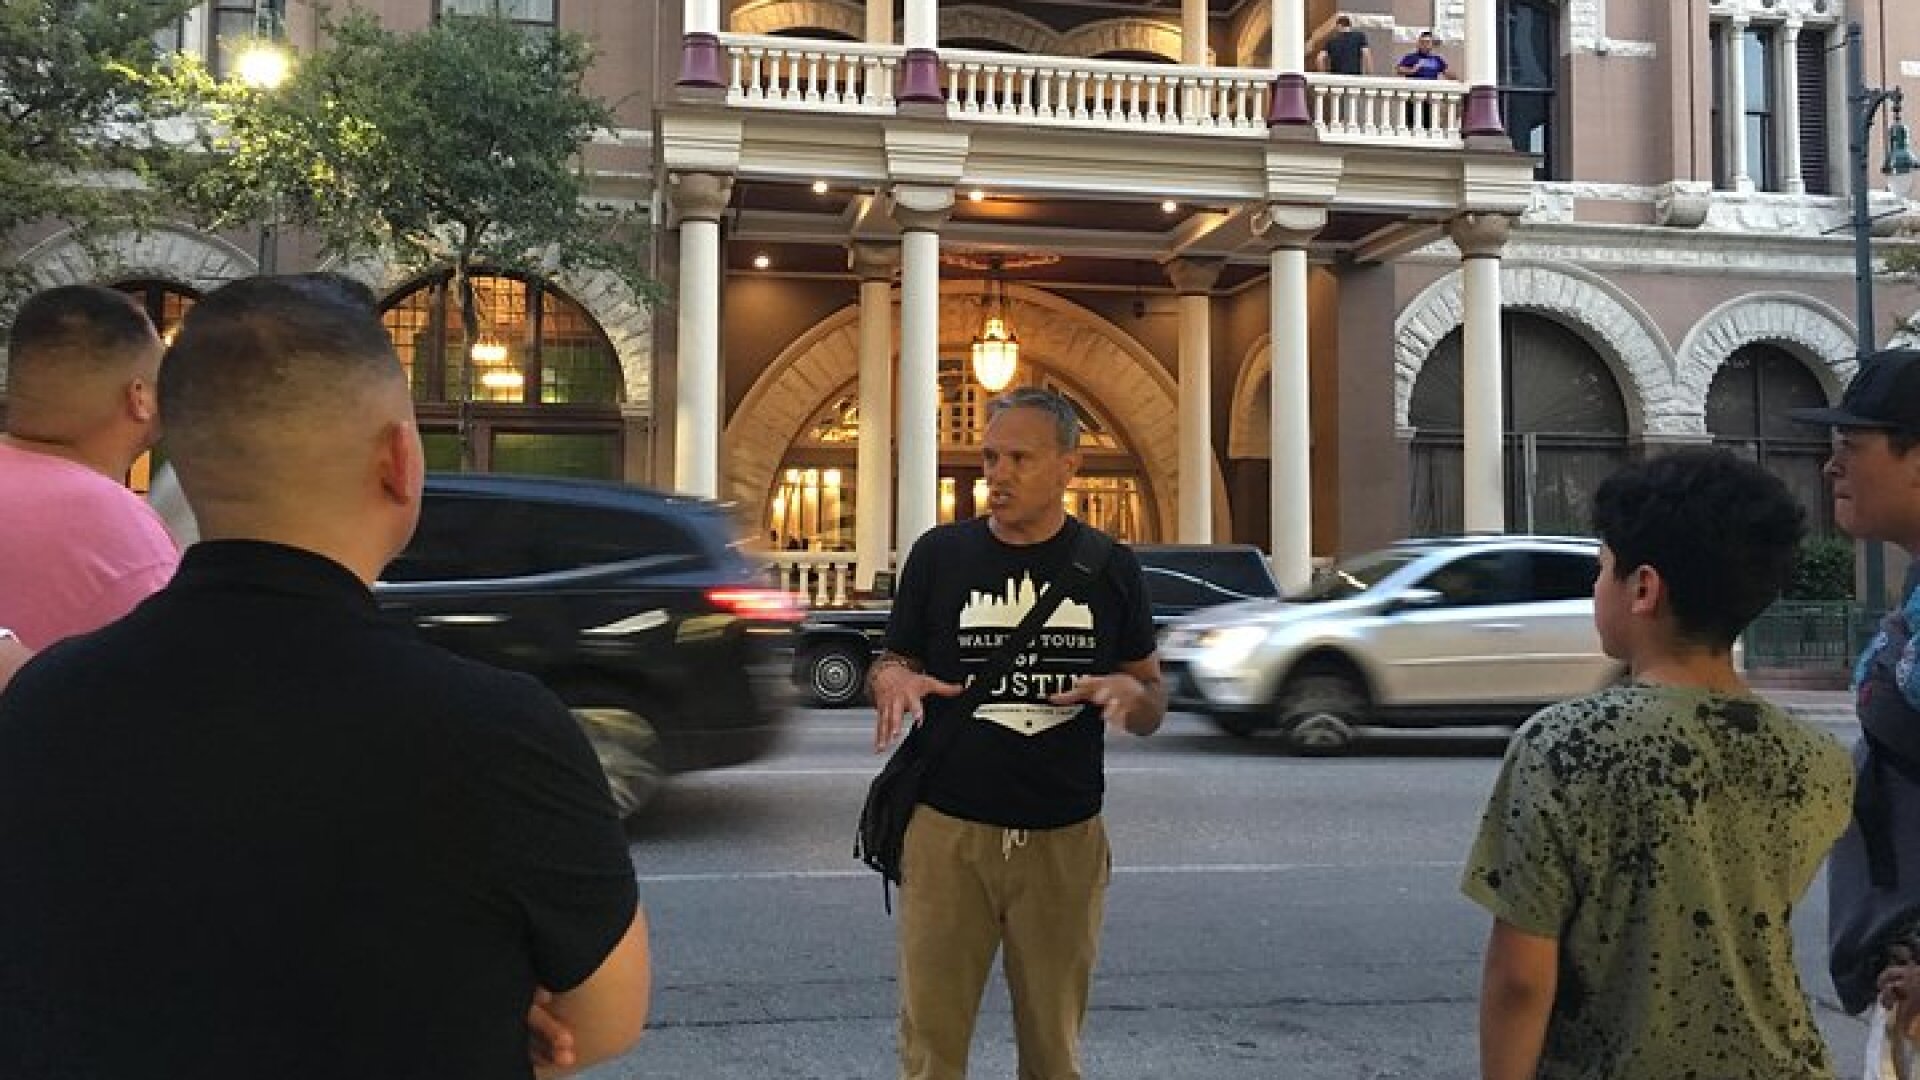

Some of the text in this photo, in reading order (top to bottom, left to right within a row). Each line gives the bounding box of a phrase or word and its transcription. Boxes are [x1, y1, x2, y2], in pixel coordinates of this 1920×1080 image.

[957, 634, 1096, 648] WALK TOURS
[1015, 653, 1038, 666] OF
